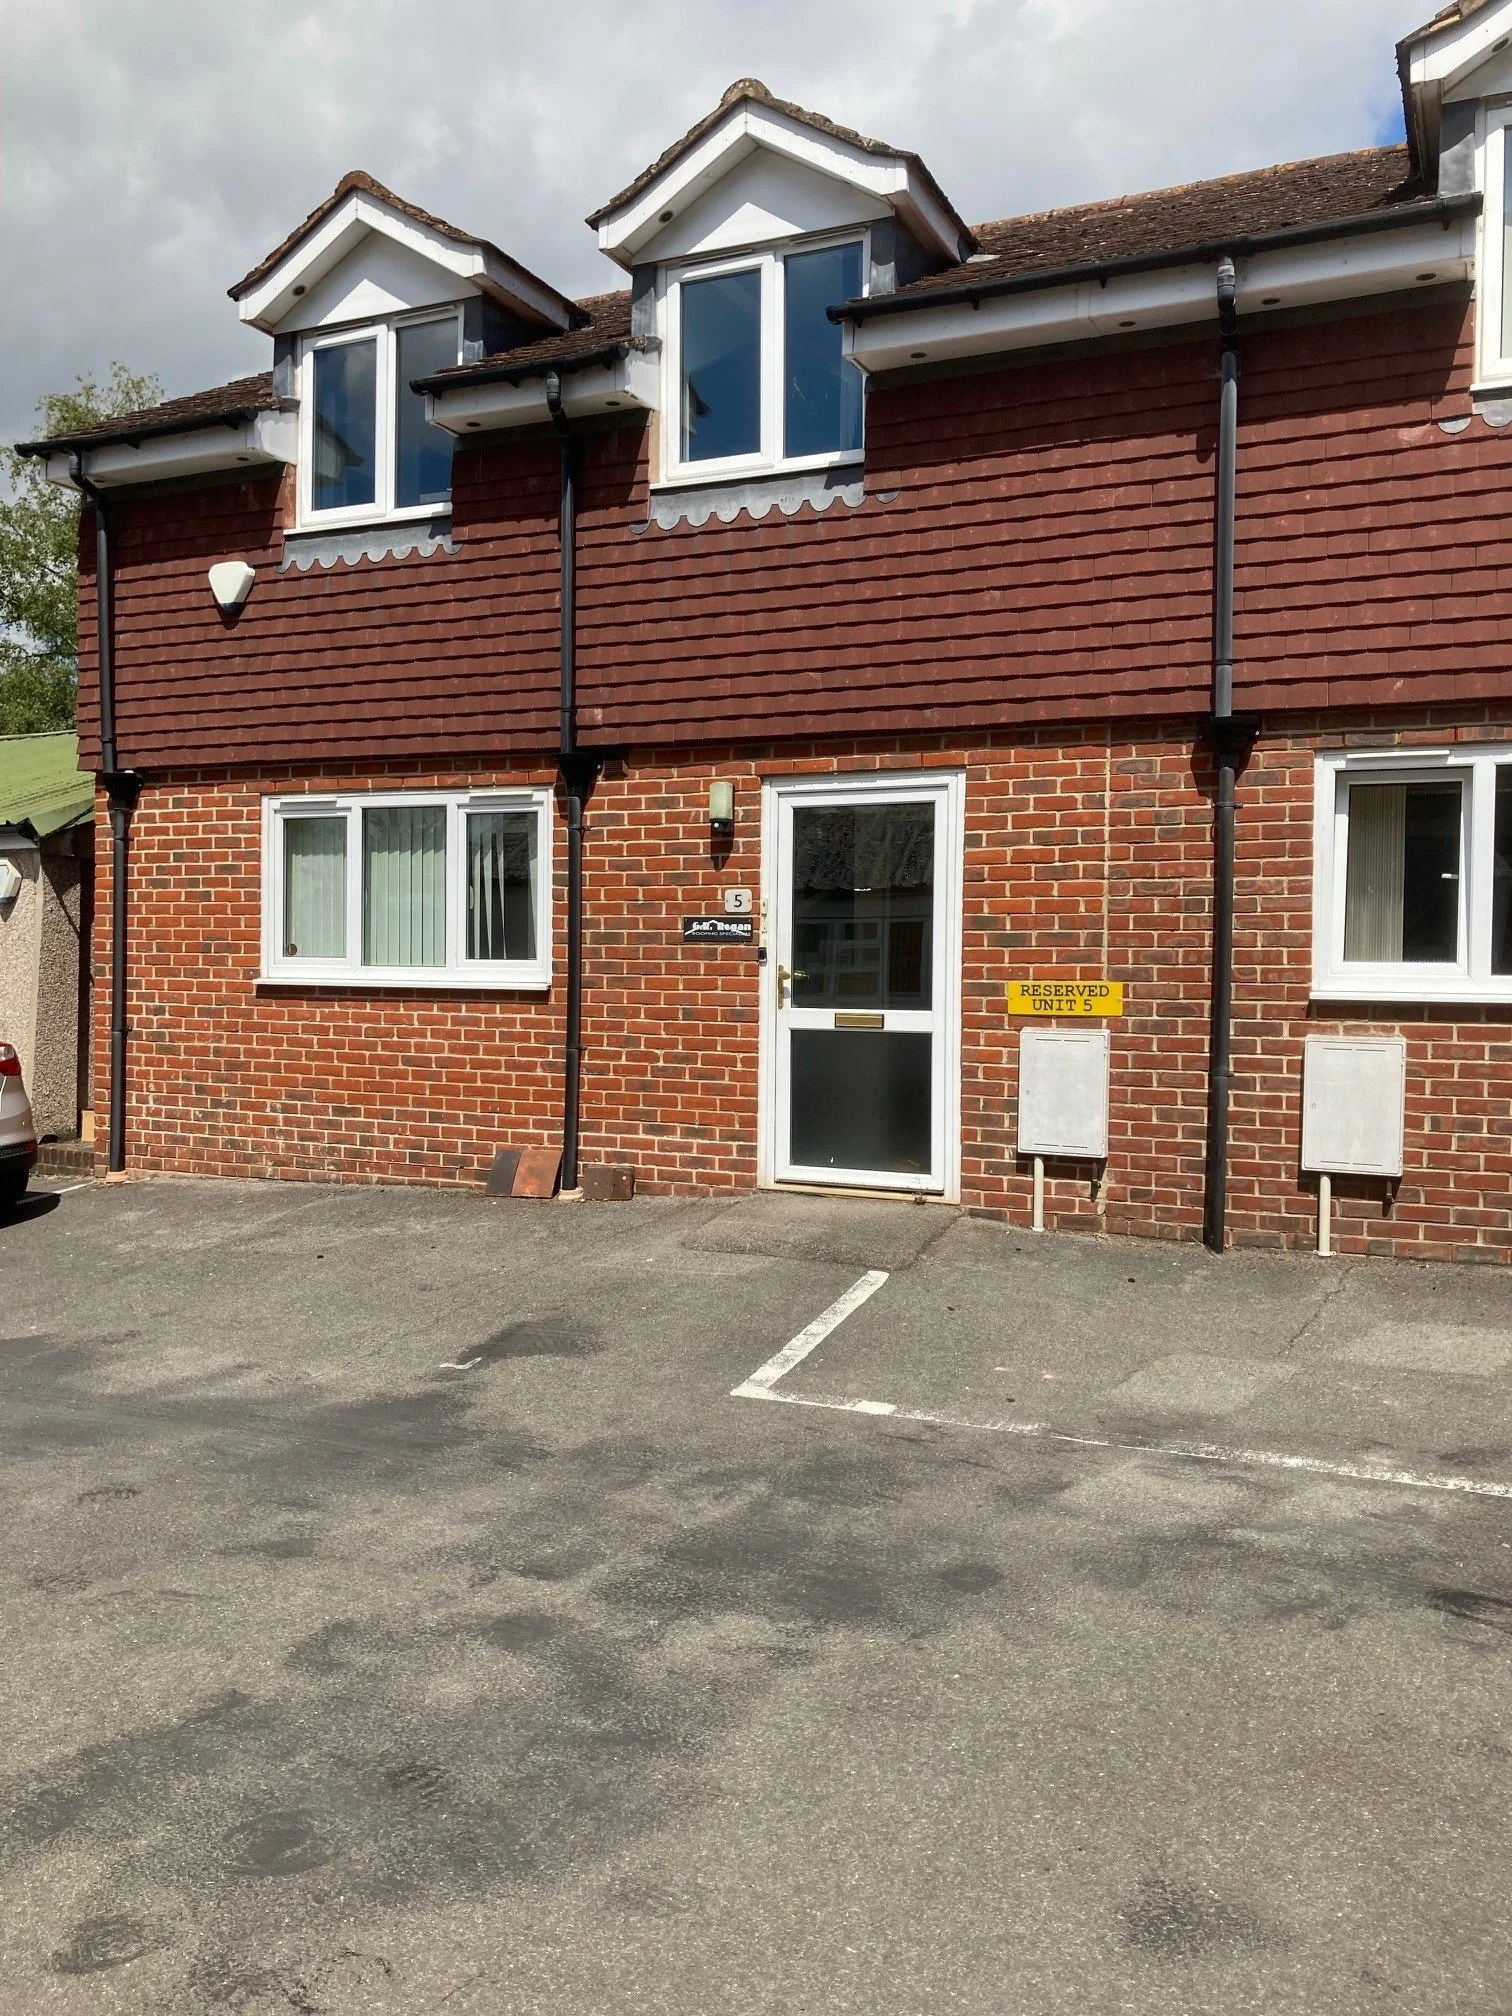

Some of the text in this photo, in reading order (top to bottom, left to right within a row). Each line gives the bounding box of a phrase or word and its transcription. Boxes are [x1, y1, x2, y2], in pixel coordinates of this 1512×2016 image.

[733, 894, 742, 908] 5
[717, 921, 752, 931] Regan
[1020, 984, 1110, 997] RESERVED
[1032, 999, 1093, 1012] UNIT 5
